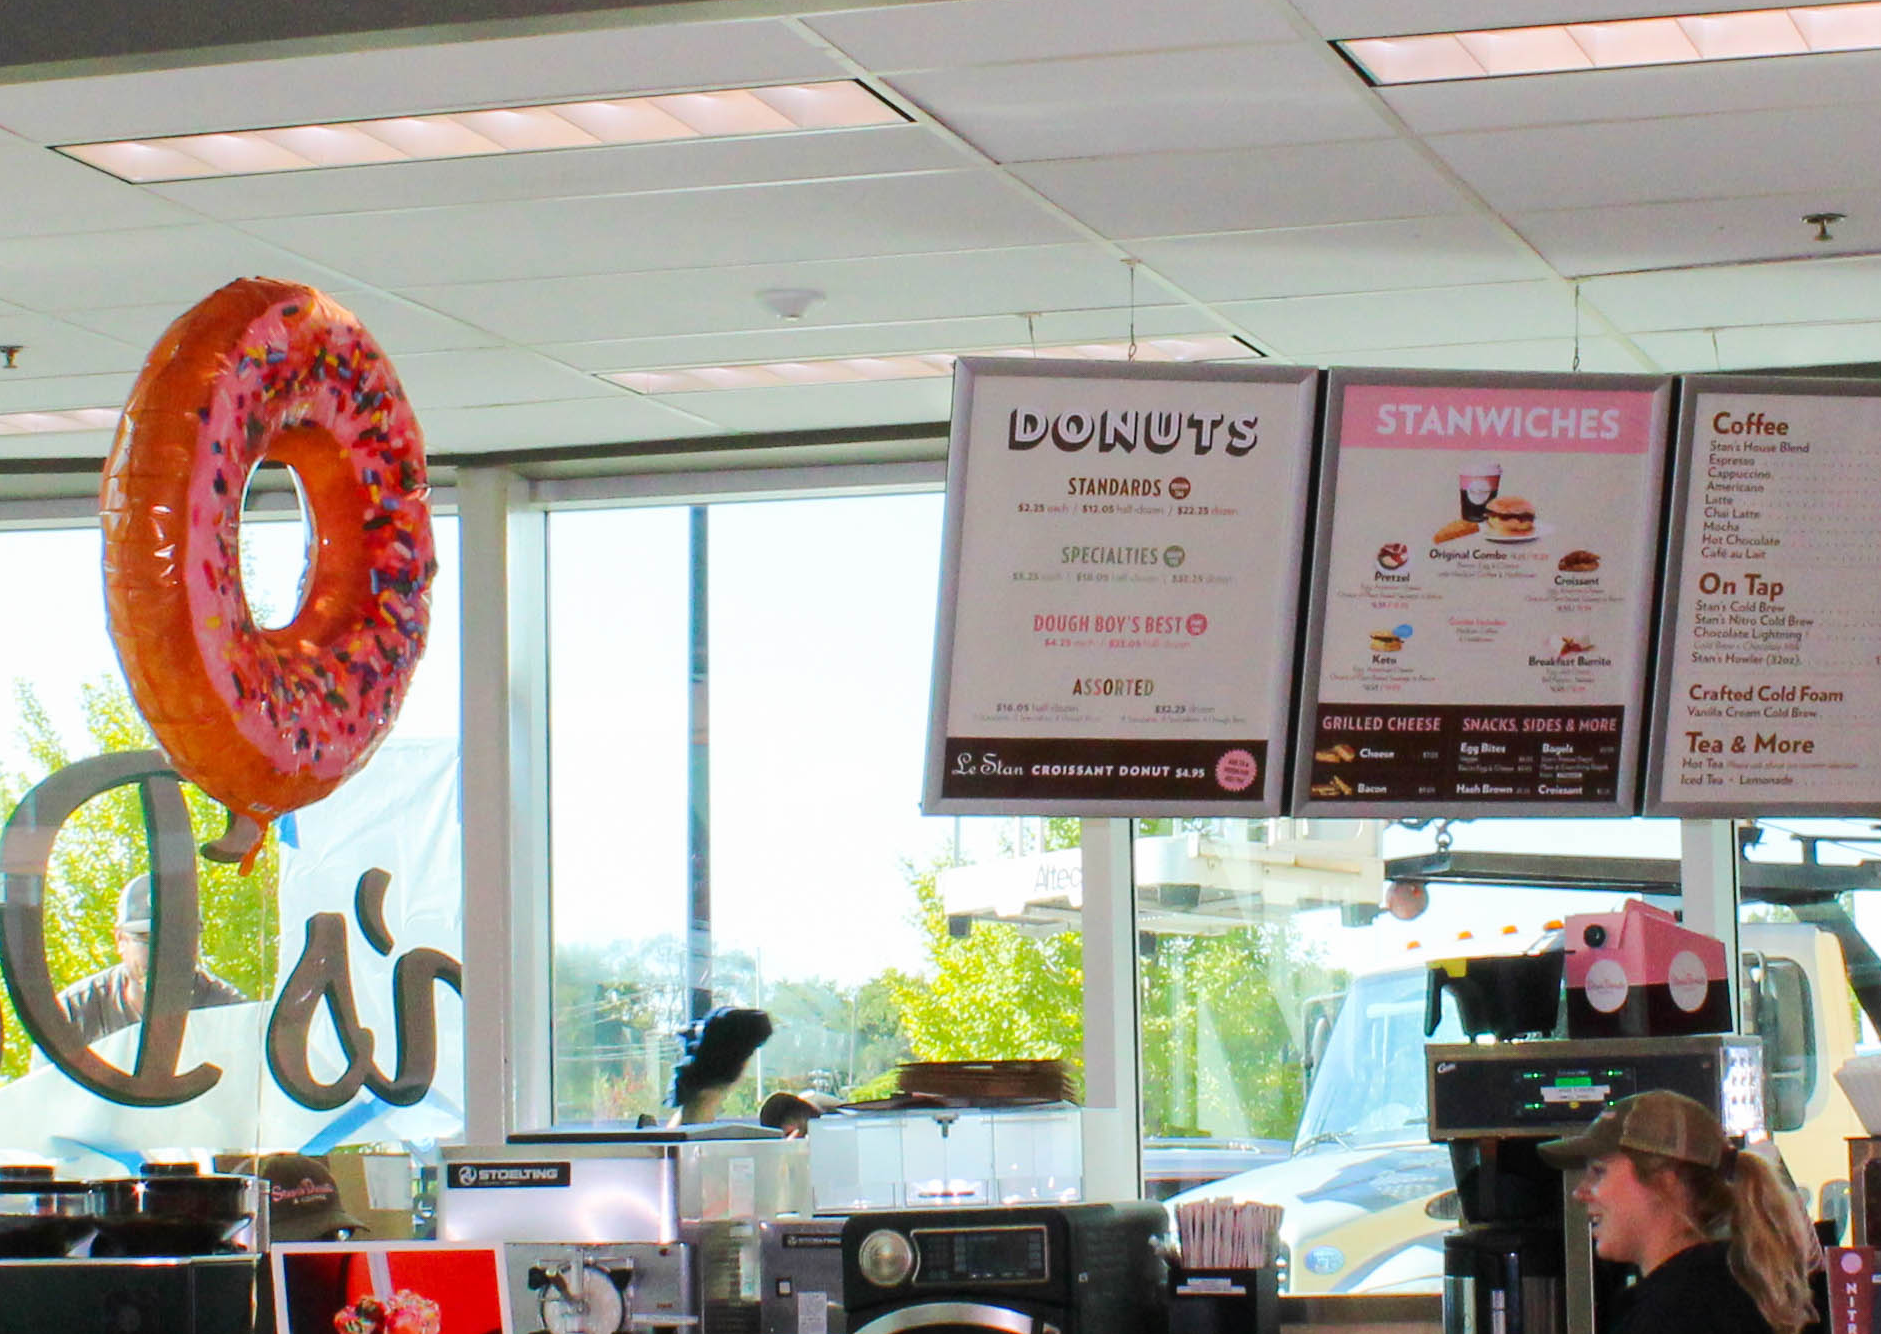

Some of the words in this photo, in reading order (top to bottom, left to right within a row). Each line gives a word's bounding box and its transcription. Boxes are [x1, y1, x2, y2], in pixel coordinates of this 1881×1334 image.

[1375, 403, 1620, 440] STANWICHES
[1712, 412, 1790, 436] Coffee
[1009, 407, 1258, 457] DONUTS
[1710, 441, 1740, 452] Stan's
[1743, 442, 1777, 453] House
[1779, 443, 1810, 454] Blend
[1709, 454, 1755, 468] Espresso
[1708, 468, 1771, 481] Cappuccino
[1068, 477, 1161, 496] STANDARDS
[1706, 481, 1764, 493] Americano
[1705, 494, 1734, 505] Latte
[1018, 503, 1045, 513] $2.25
[1704, 507, 1731, 518] Chai
[1732, 509, 1760, 519] Latte
[1703, 521, 1740, 532] Mocha
[1702, 535, 1723, 545] Hot
[1726, 535, 1781, 546] Chocolate
[1061, 546, 1158, 564] SPECIALTIES
[1429, 548, 1470, 561] Original
[1472, 549, 1507, 561] Combo
[1730, 551, 1743, 559] au
[1745, 549, 1766, 559] Lait
[1374, 572, 1411, 583] Pretzel
[1554, 575, 1599, 586] Croissant
[1698, 572, 1737, 596] On
[1744, 573, 1784, 601] Tap
[1695, 600, 1727, 612] Stan's
[1730, 601, 1756, 613] Cold
[1759, 602, 1785, 613] Brew
[1033, 614, 1089, 633] DOUGH
[1094, 615, 1140, 634] BOY'S
[1145, 616, 1182, 634] BEST
[1694, 614, 1726, 625] Stan's
[1729, 615, 1757, 626] Nitro
[1759, 615, 1786, 627] Cold
[1788, 617, 1814, 627] Brew
[1693, 627, 1750, 639] Chocolate
[1752, 628, 1802, 642] Lightning
[1372, 655, 1397, 666] Keto
[1528, 656, 1574, 667] Breakfast
[1577, 656, 1611, 667] Burrito
[1691, 652, 1723, 663] Stan's
[1725, 653, 1763, 664] Howler
[1072, 678, 1154, 696] ASSORTED
[1689, 684, 1753, 702] Crafted
[1758, 685, 1796, 702] Cold
[1800, 687, 1844, 702] Foam
[1687, 706, 1721, 717] Vanilla
[1725, 707, 1761, 718] Cream
[1763, 708, 1789, 718] Cold
[1791, 708, 1816, 718] Brew
[1322, 716, 1383, 731] GRILLED
[1387, 717, 1442, 732] CHEESE
[1523, 718, 1561, 732] SIDES
[1566, 719, 1575, 732] &
[1579, 719, 1617, 732] MORE
[1685, 731, 1723, 754] Tea
[1731, 734, 1746, 753] &
[1754, 733, 1815, 754] More
[1359, 748, 1395, 759] Cheese
[1460, 743, 1480, 755] Egg
[1481, 744, 1506, 754] Bites
[1542, 743, 1574, 755] Bagels
[980, 753, 1024, 777] Stan
[1031, 764, 1114, 777] CROISSANT
[1119, 765, 1170, 777] DONUT
[1175, 767, 1205, 779] $4.95
[1682, 759, 1704, 769] Hot
[1706, 759, 1724, 769] Tea
[1680, 774, 1703, 785] Iced
[1706, 775, 1723, 785] Tea
[1740, 775, 1793, 785] Lemonade
[1357, 784, 1387, 794] Bacon
[1456, 784, 1481, 794] Hash
[1482, 785, 1513, 794] Brown
[1538, 785, 1583, 796] Croissant
[478, 1168, 559, 1180] STOELTING
